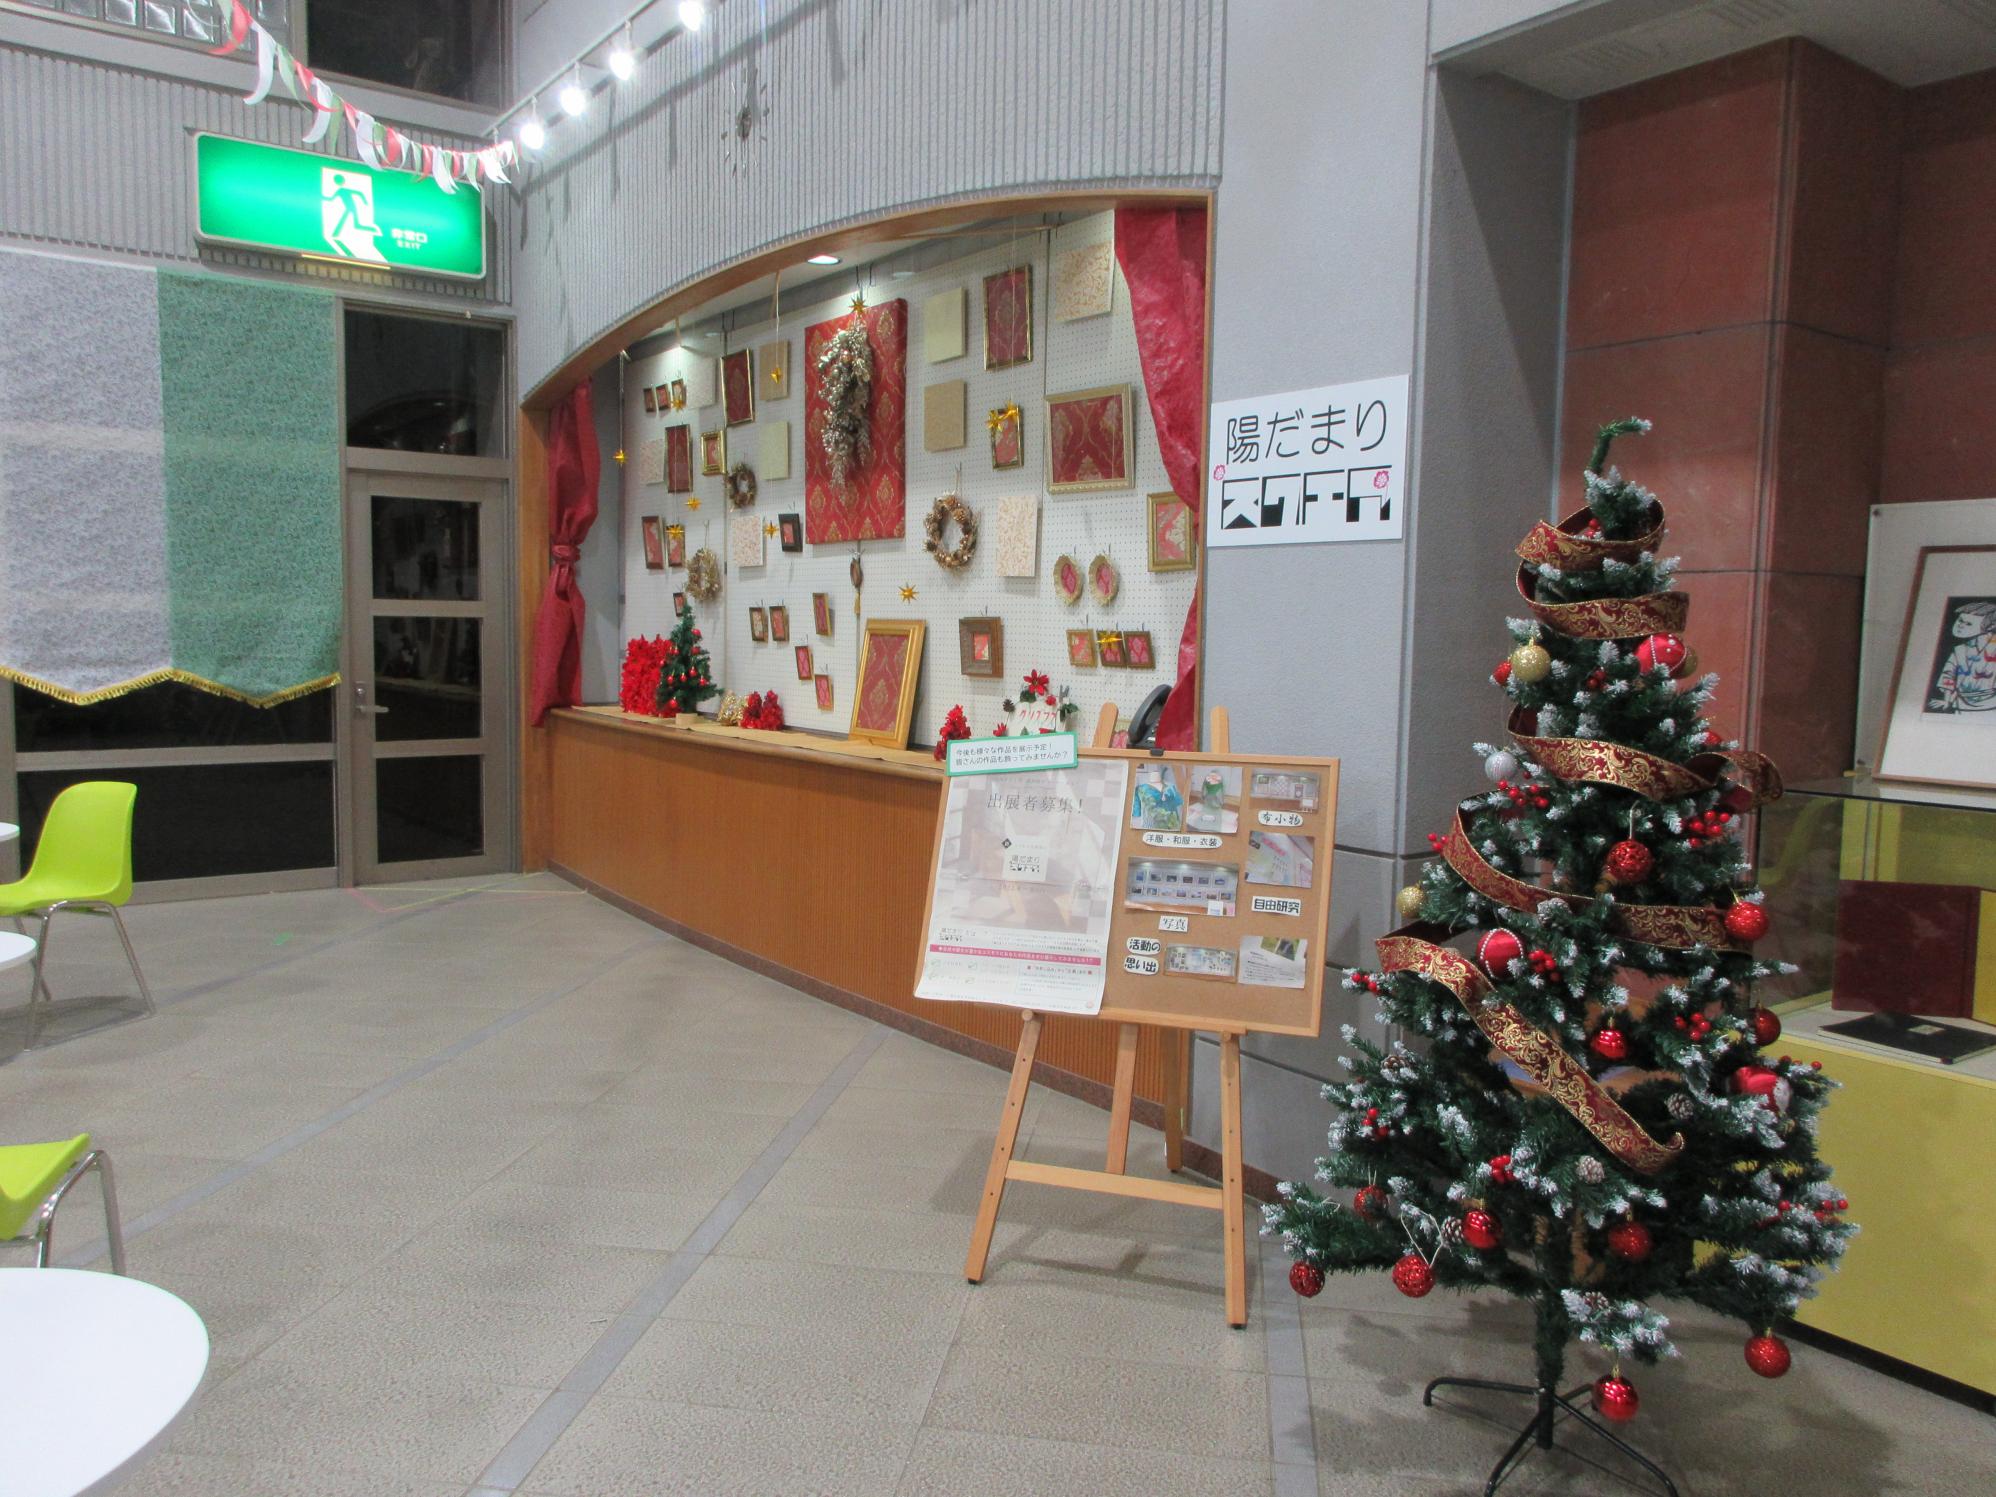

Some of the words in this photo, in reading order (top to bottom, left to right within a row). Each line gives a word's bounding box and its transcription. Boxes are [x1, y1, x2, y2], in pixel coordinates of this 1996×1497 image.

[1226, 400, 1387, 465] 陽だまり
[1263, 811, 1301, 826] 布小物
[1145, 834, 1219, 847] 洋服・和服・衣装
[1254, 898, 1301, 914] 自由研究
[1162, 917, 1187, 931] 写真
[1129, 938, 1161, 952] 活動の
[1124, 957, 1157, 973] 思い出
